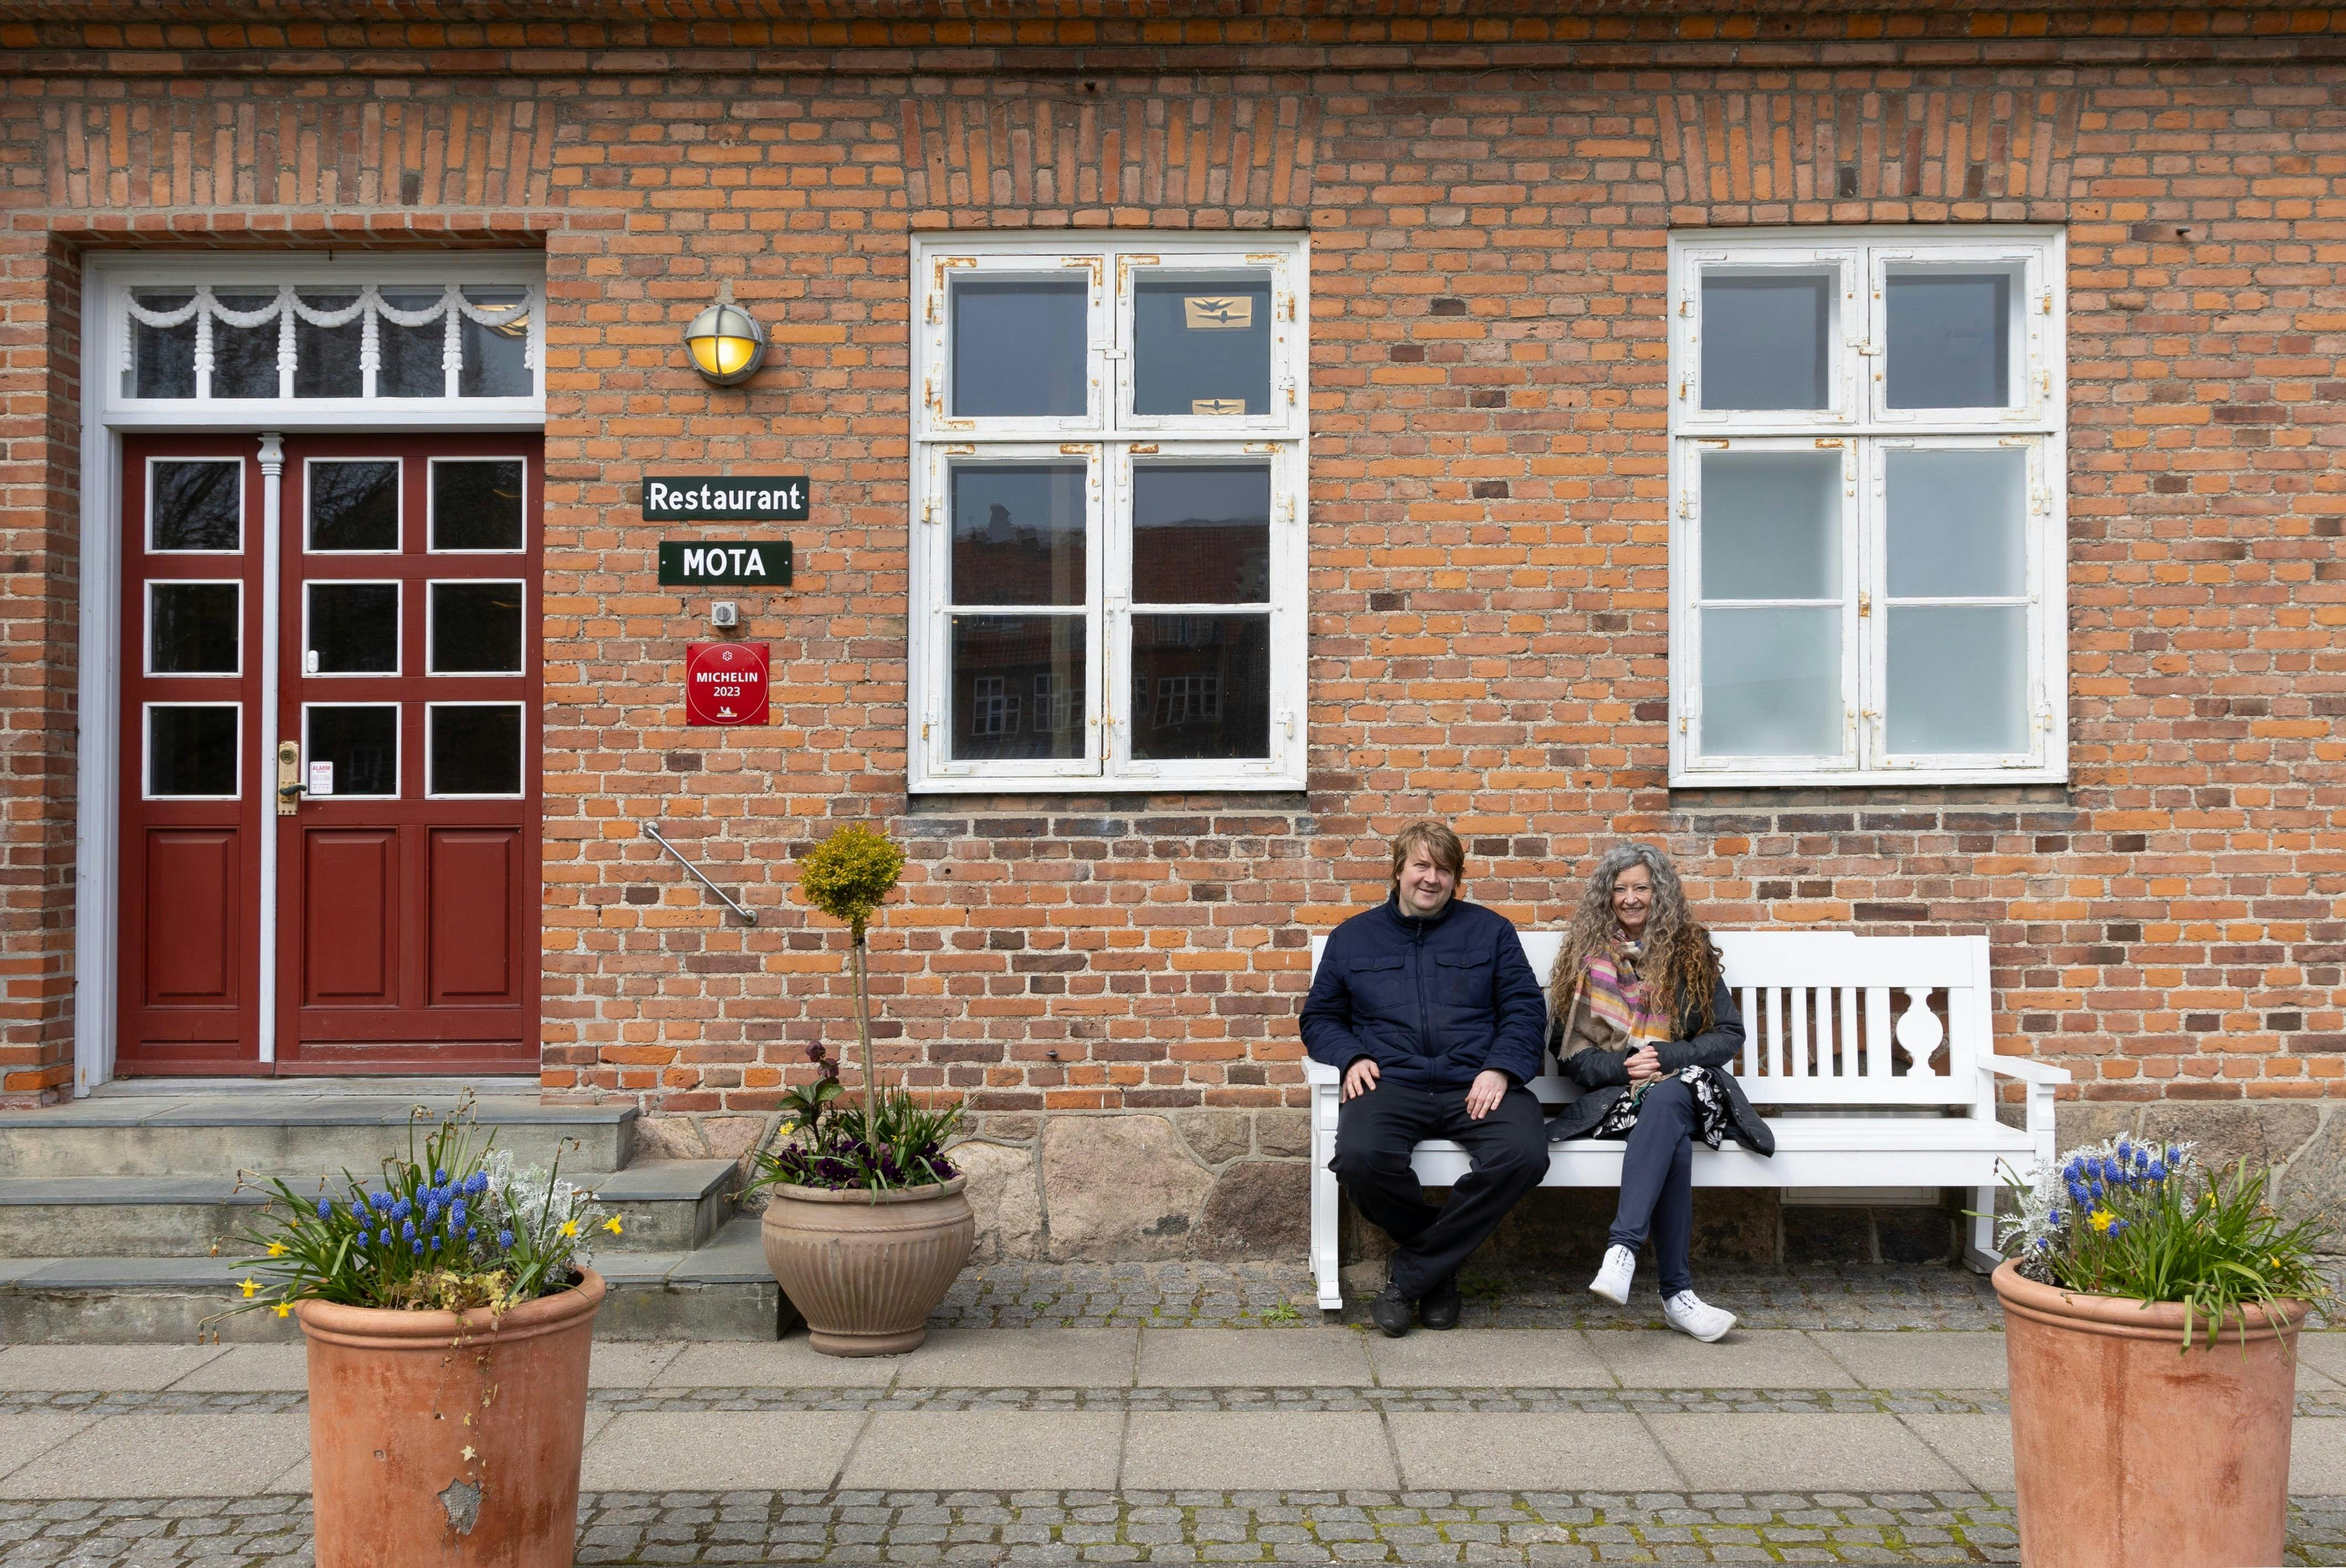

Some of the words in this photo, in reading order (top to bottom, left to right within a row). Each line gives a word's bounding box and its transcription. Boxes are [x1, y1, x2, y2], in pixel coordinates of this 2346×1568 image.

[650, 482, 801, 510] Restaurant
[683, 548, 766, 576] MOTA
[697, 672, 757, 682] MICHELIN
[714, 686, 740, 697] 2023
